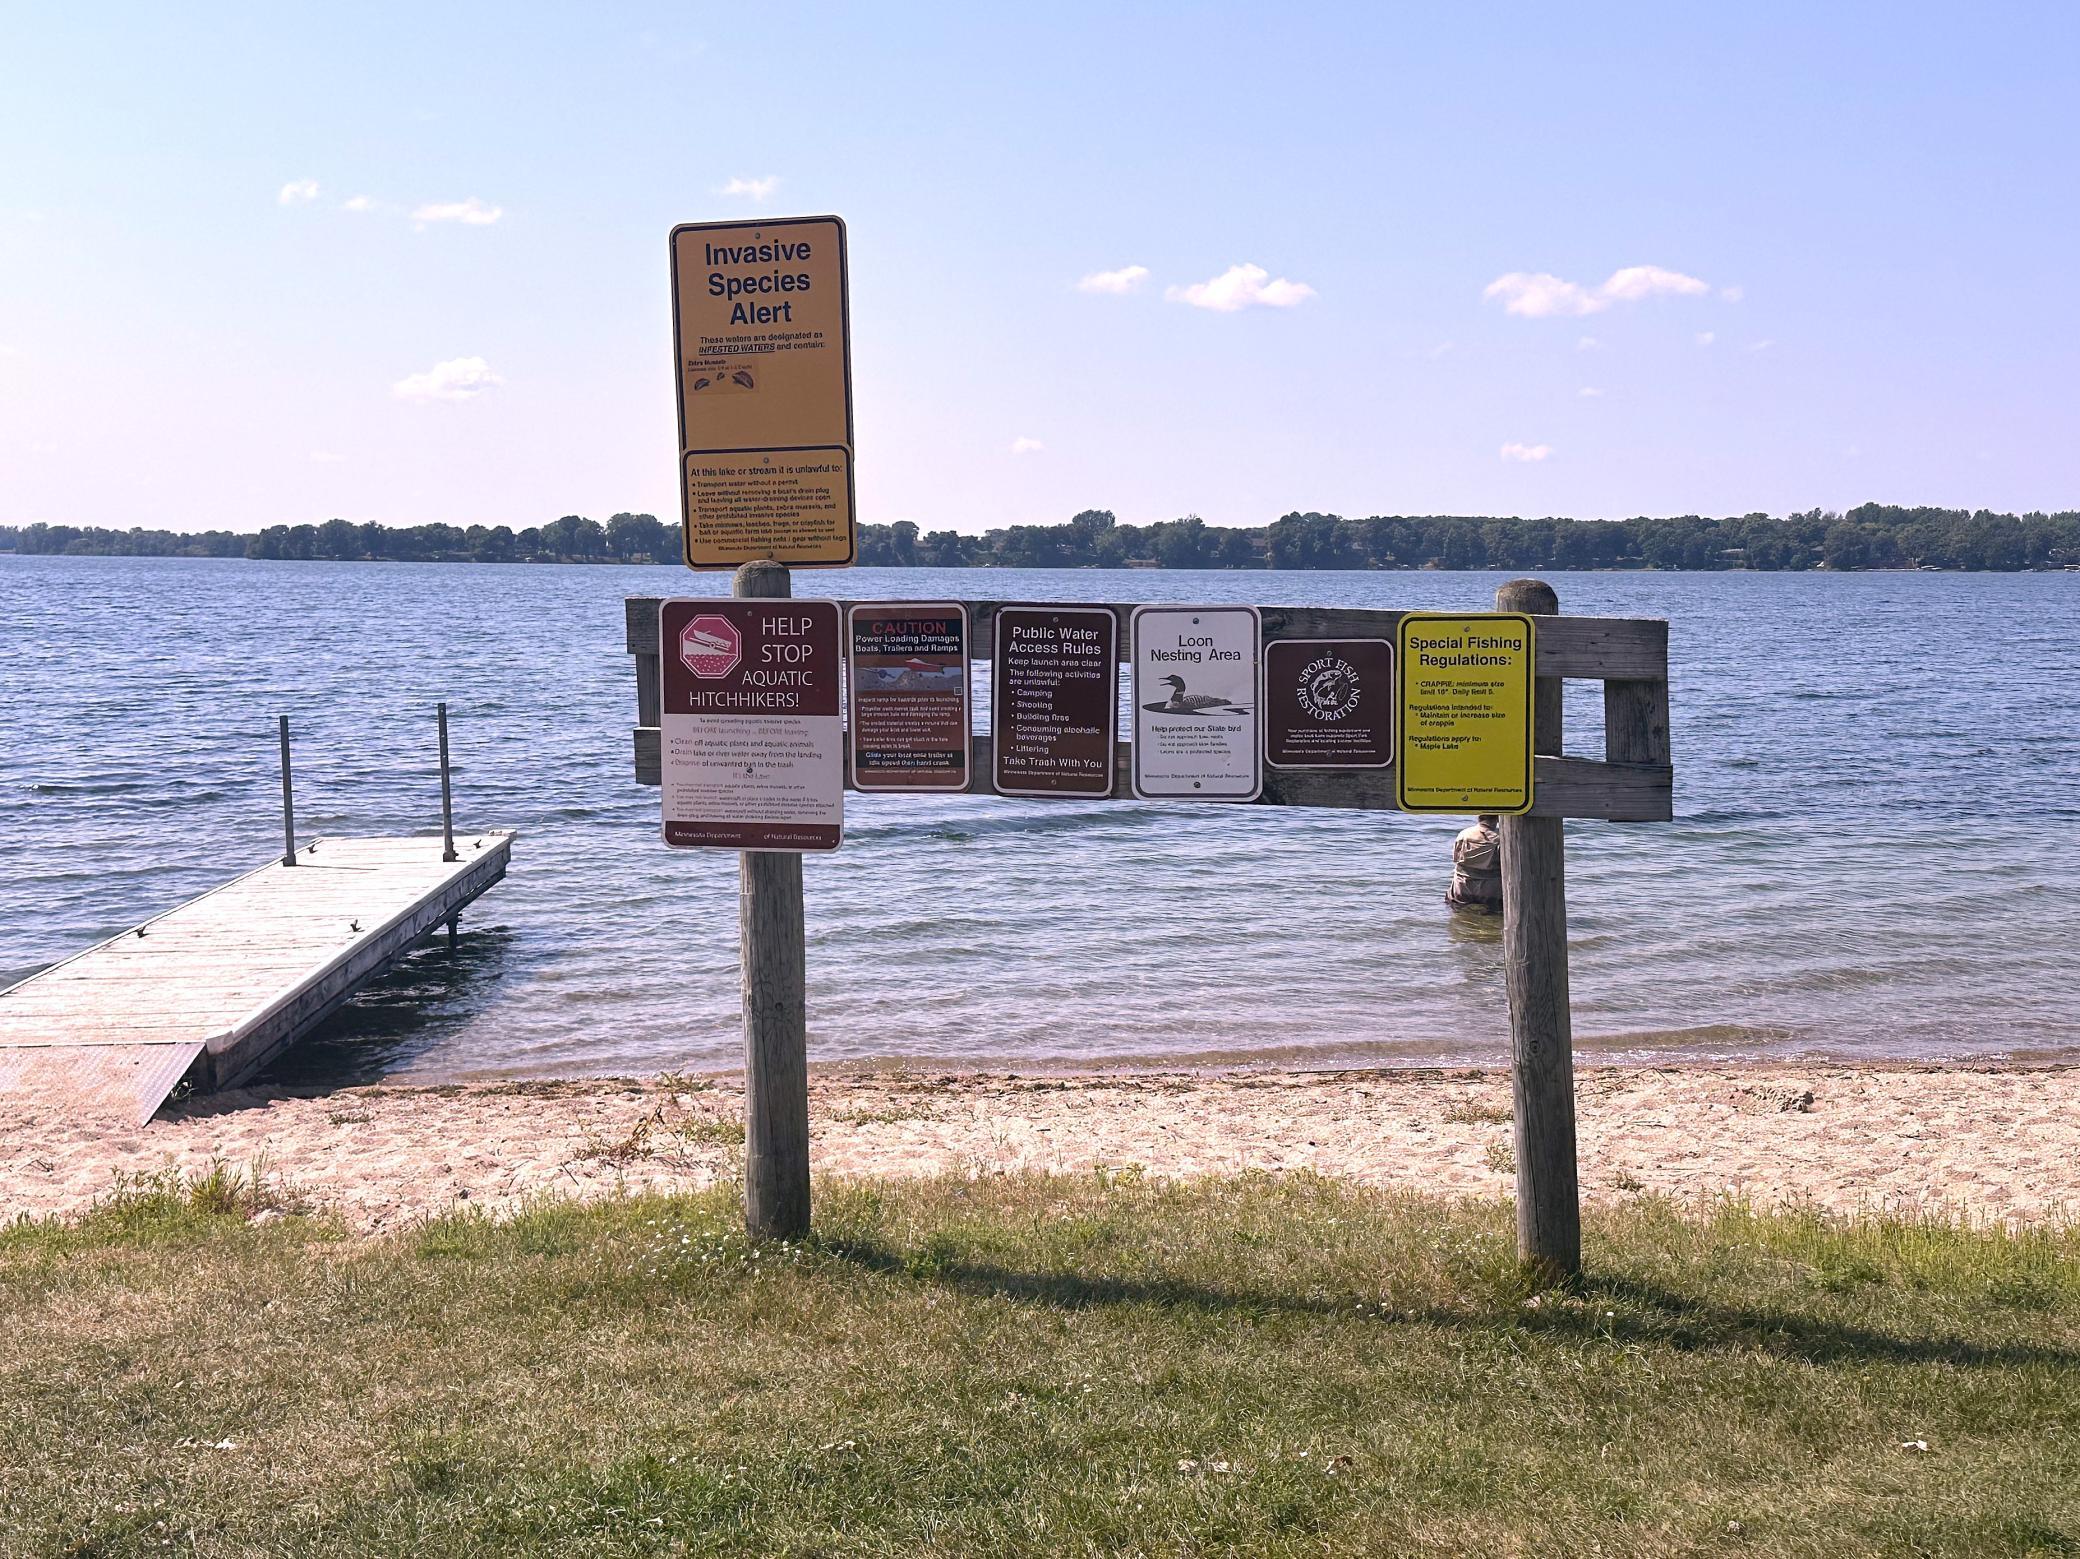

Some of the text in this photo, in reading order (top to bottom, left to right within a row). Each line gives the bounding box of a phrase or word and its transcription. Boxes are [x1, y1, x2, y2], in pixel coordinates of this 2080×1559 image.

[705, 239, 811, 265] Invasive
[708, 270, 811, 300] Species
[730, 301, 792, 325] Alert
[768, 332, 812, 341] designated
[699, 344, 739, 353] INFESTED
[740, 343, 775, 352] WATERS
[691, 468, 700, 476] At
[702, 468, 716, 476] this
[719, 467, 736, 475] lake
[749, 467, 777, 475] stream
[779, 466, 784, 474] it
[796, 465, 830, 473] unlawful
[833, 534, 846, 542] tags
[762, 617, 813, 636] HELP
[873, 622, 946, 634] CAUTION
[885, 635, 919, 644] Loading
[921, 635, 959, 643] Damages
[1013, 627, 1098, 640] Public Water
[1178, 635, 1213, 647] Loon
[1410, 637, 1521, 651] Special Fishing
[761, 644, 813, 663] STOP
[931, 644, 958, 652] Ramps
[1009, 641, 1101, 654] Access Rules
[1009, 658, 1029, 666] Keep
[1032, 658, 1059, 666] launch
[1151, 649, 1241, 663] Nesting Area
[1420, 654, 1511, 668] Regulations:
[1027, 670, 1062, 679] following
[1299, 658, 1360, 684] SPORT FISH
[742, 670, 813, 687] AQUATIC
[689, 691, 799, 707] HITCHHIKERS!
[1017, 689, 1052, 698] Camping
[1016, 701, 1052, 710] Shooting
[1297, 688, 1360, 720] RESTORATION
[1017, 713, 1049, 722] Building
[1016, 725, 1100, 734] Consuming alcoholic
[729, 740, 749, 748] plants
[1016, 734, 1056, 742] beverages
[1016, 745, 1049, 754] Littering
[798, 752, 822, 760] landing
[1003, 756, 1102, 768] Take Trash With You
